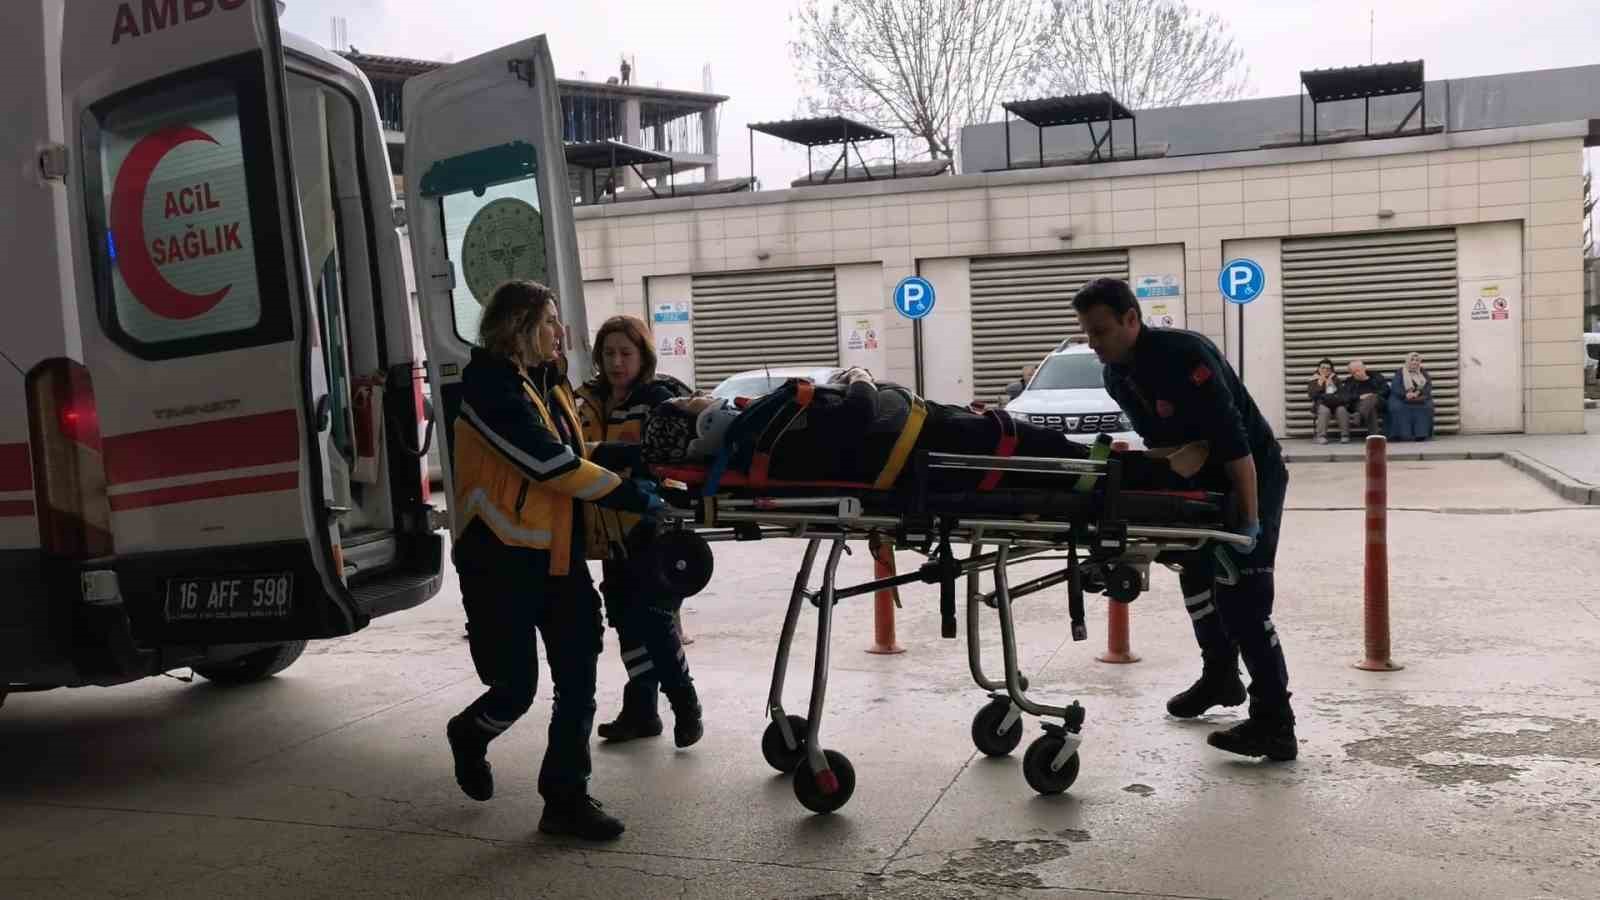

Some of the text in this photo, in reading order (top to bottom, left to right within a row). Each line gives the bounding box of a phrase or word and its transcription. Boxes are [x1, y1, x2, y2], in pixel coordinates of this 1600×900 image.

[111, 0, 244, 45] AMB
[152, 221, 243, 266] SAĞLIK
[903, 283, 925, 311] P
[1230, 266, 1253, 297] P
[180, 582, 199, 609] 16
[207, 579, 241, 608] AFF
